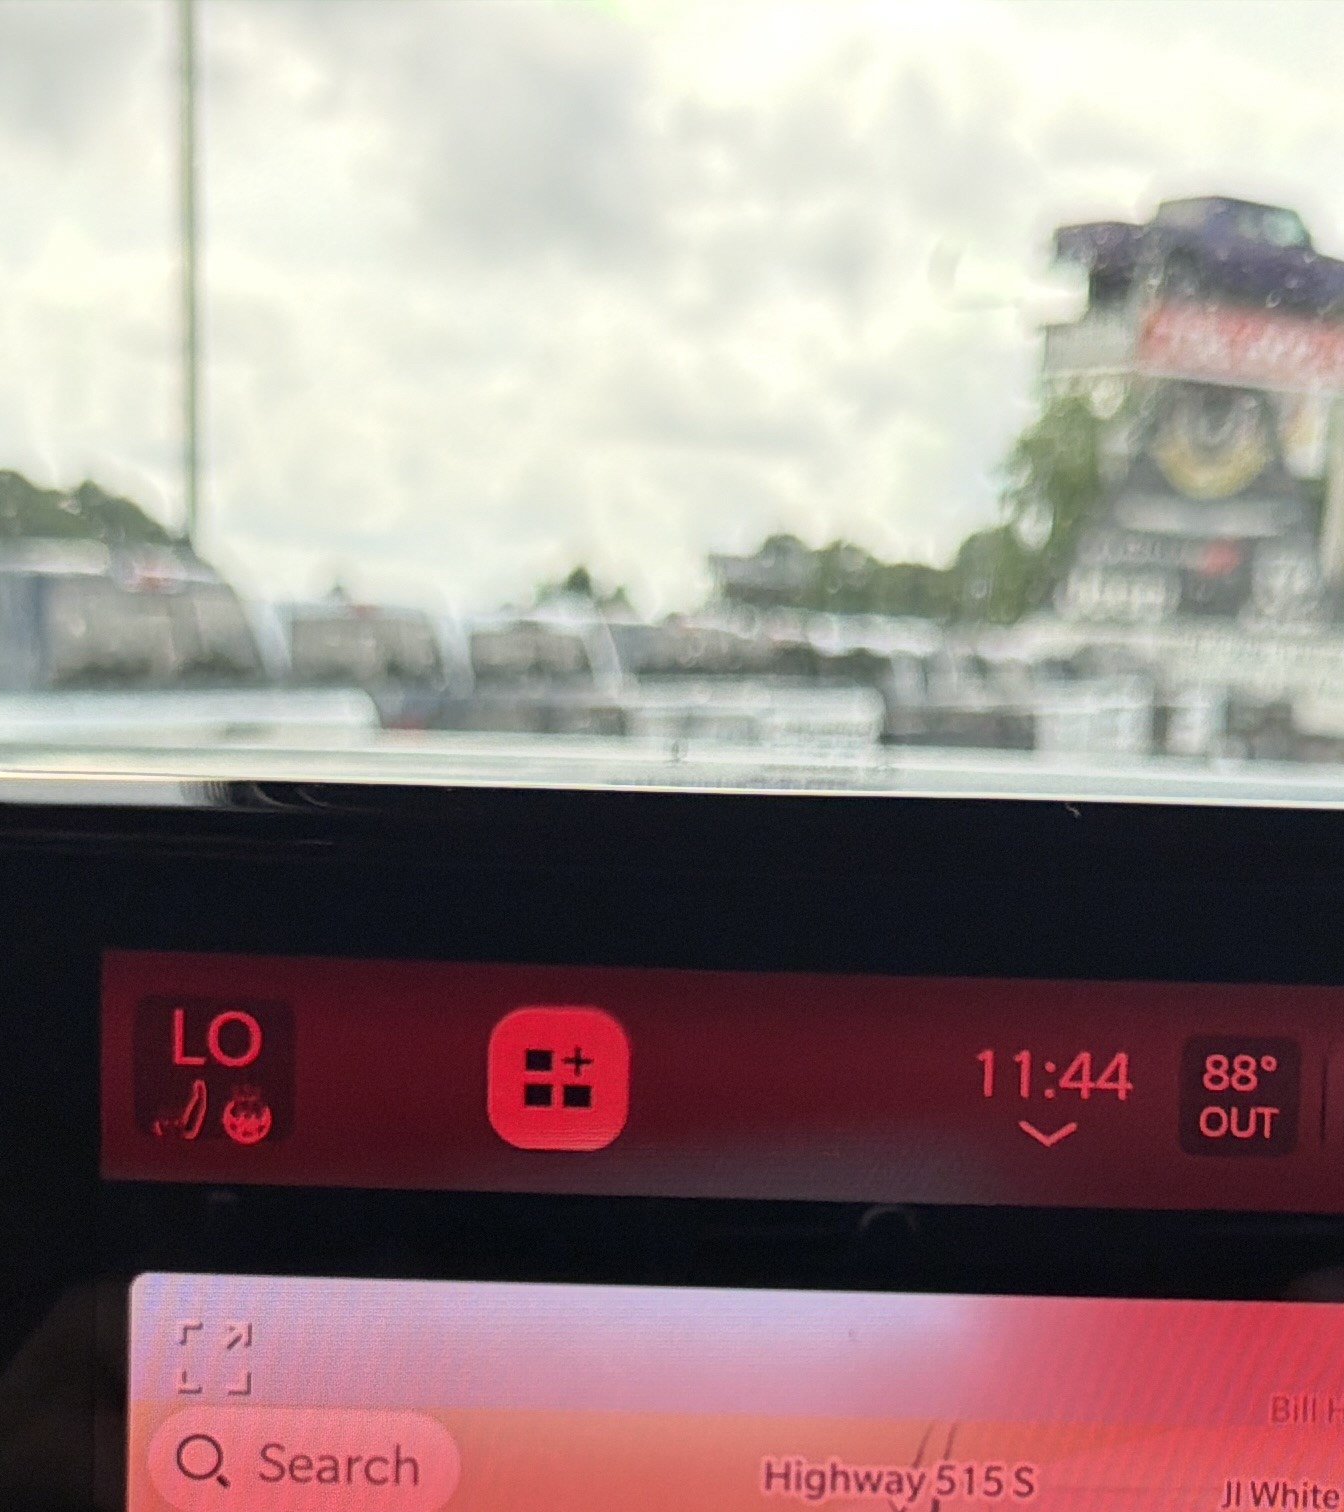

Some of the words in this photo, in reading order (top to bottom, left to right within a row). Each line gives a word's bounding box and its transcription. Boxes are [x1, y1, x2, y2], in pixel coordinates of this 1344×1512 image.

[172, 1008, 262, 1067] LO
[976, 1048, 1134, 1102] 11:44
[1201, 1054, 1278, 1093] 88°
[1198, 1106, 1278, 1140] OUT
[1270, 1396, 1317, 1424] Bill
[258, 1443, 421, 1486] Search
[764, 1460, 927, 1502] Highway
[1250, 1481, 1340, 1509] White
